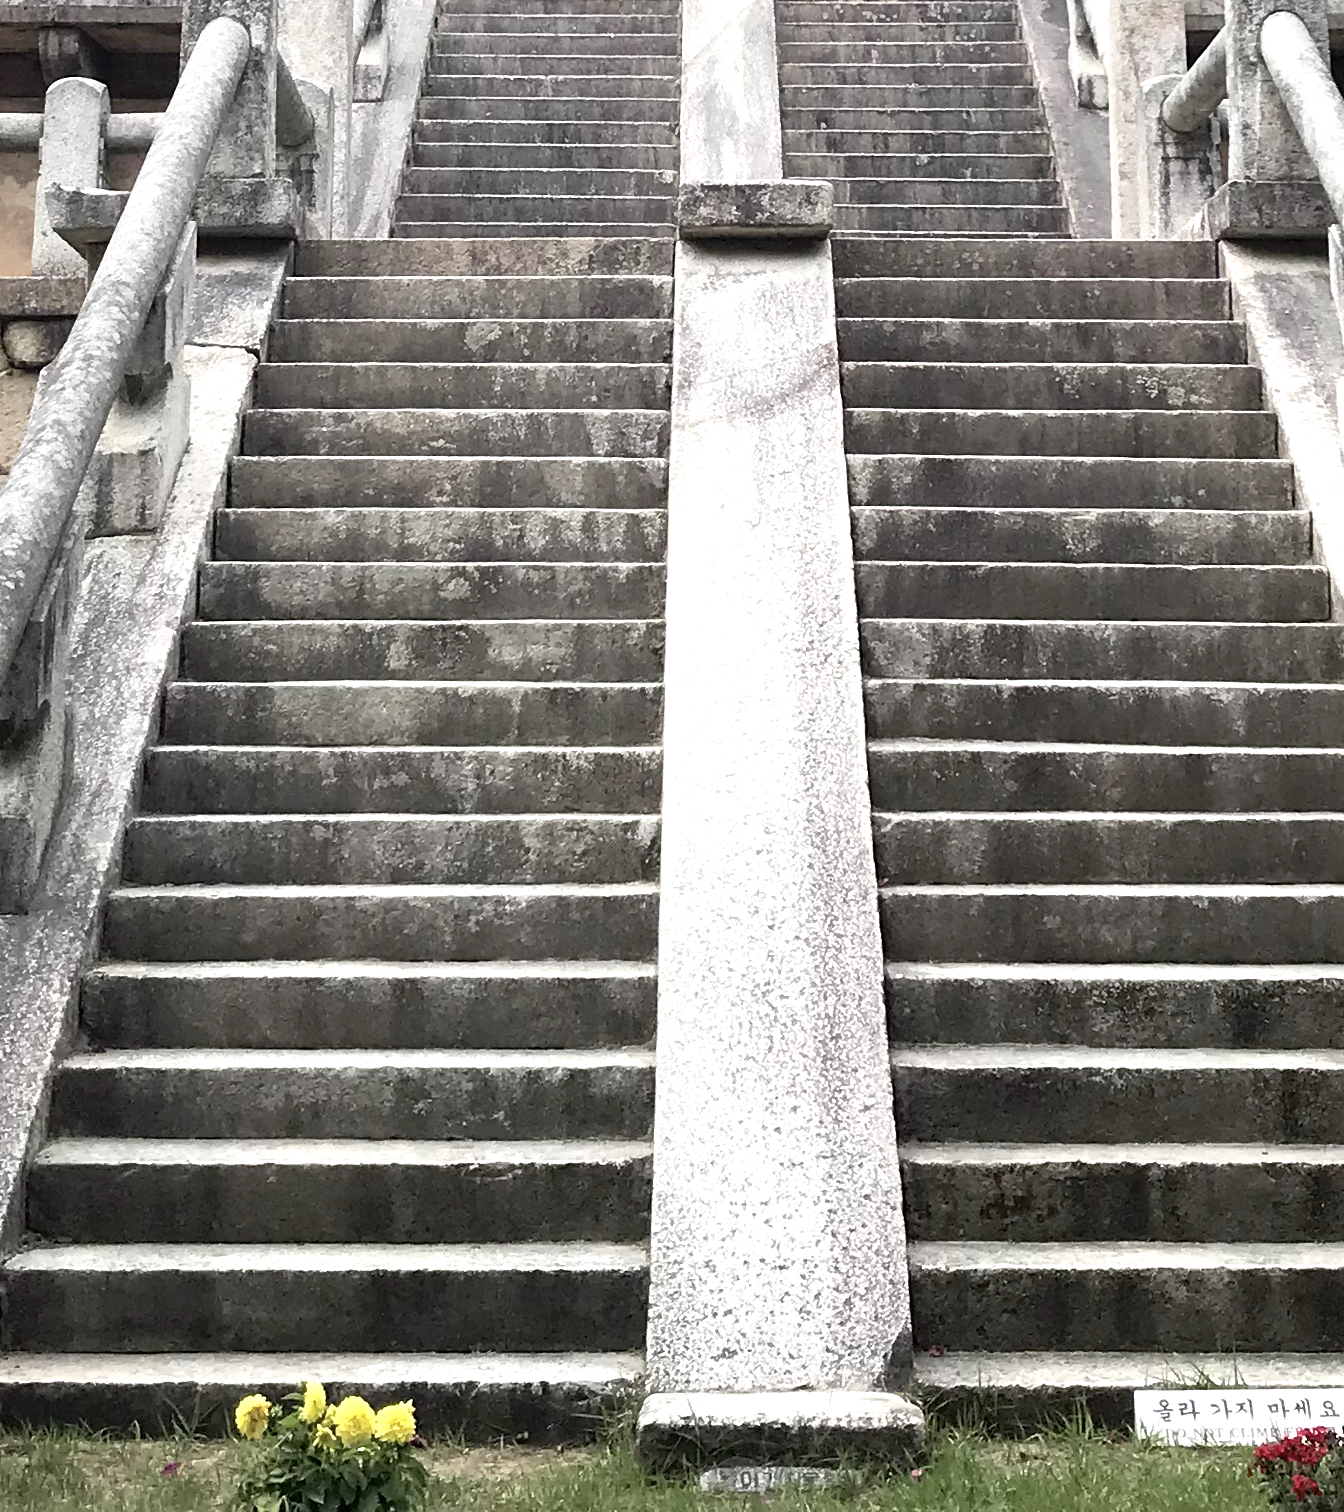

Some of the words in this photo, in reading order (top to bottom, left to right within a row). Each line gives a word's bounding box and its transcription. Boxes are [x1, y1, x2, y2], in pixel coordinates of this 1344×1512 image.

[1153, 1399, 1200, 1422] 올라
[1210, 1398, 1254, 1420] 가지
[1193, 1428, 1224, 1439] NOT
